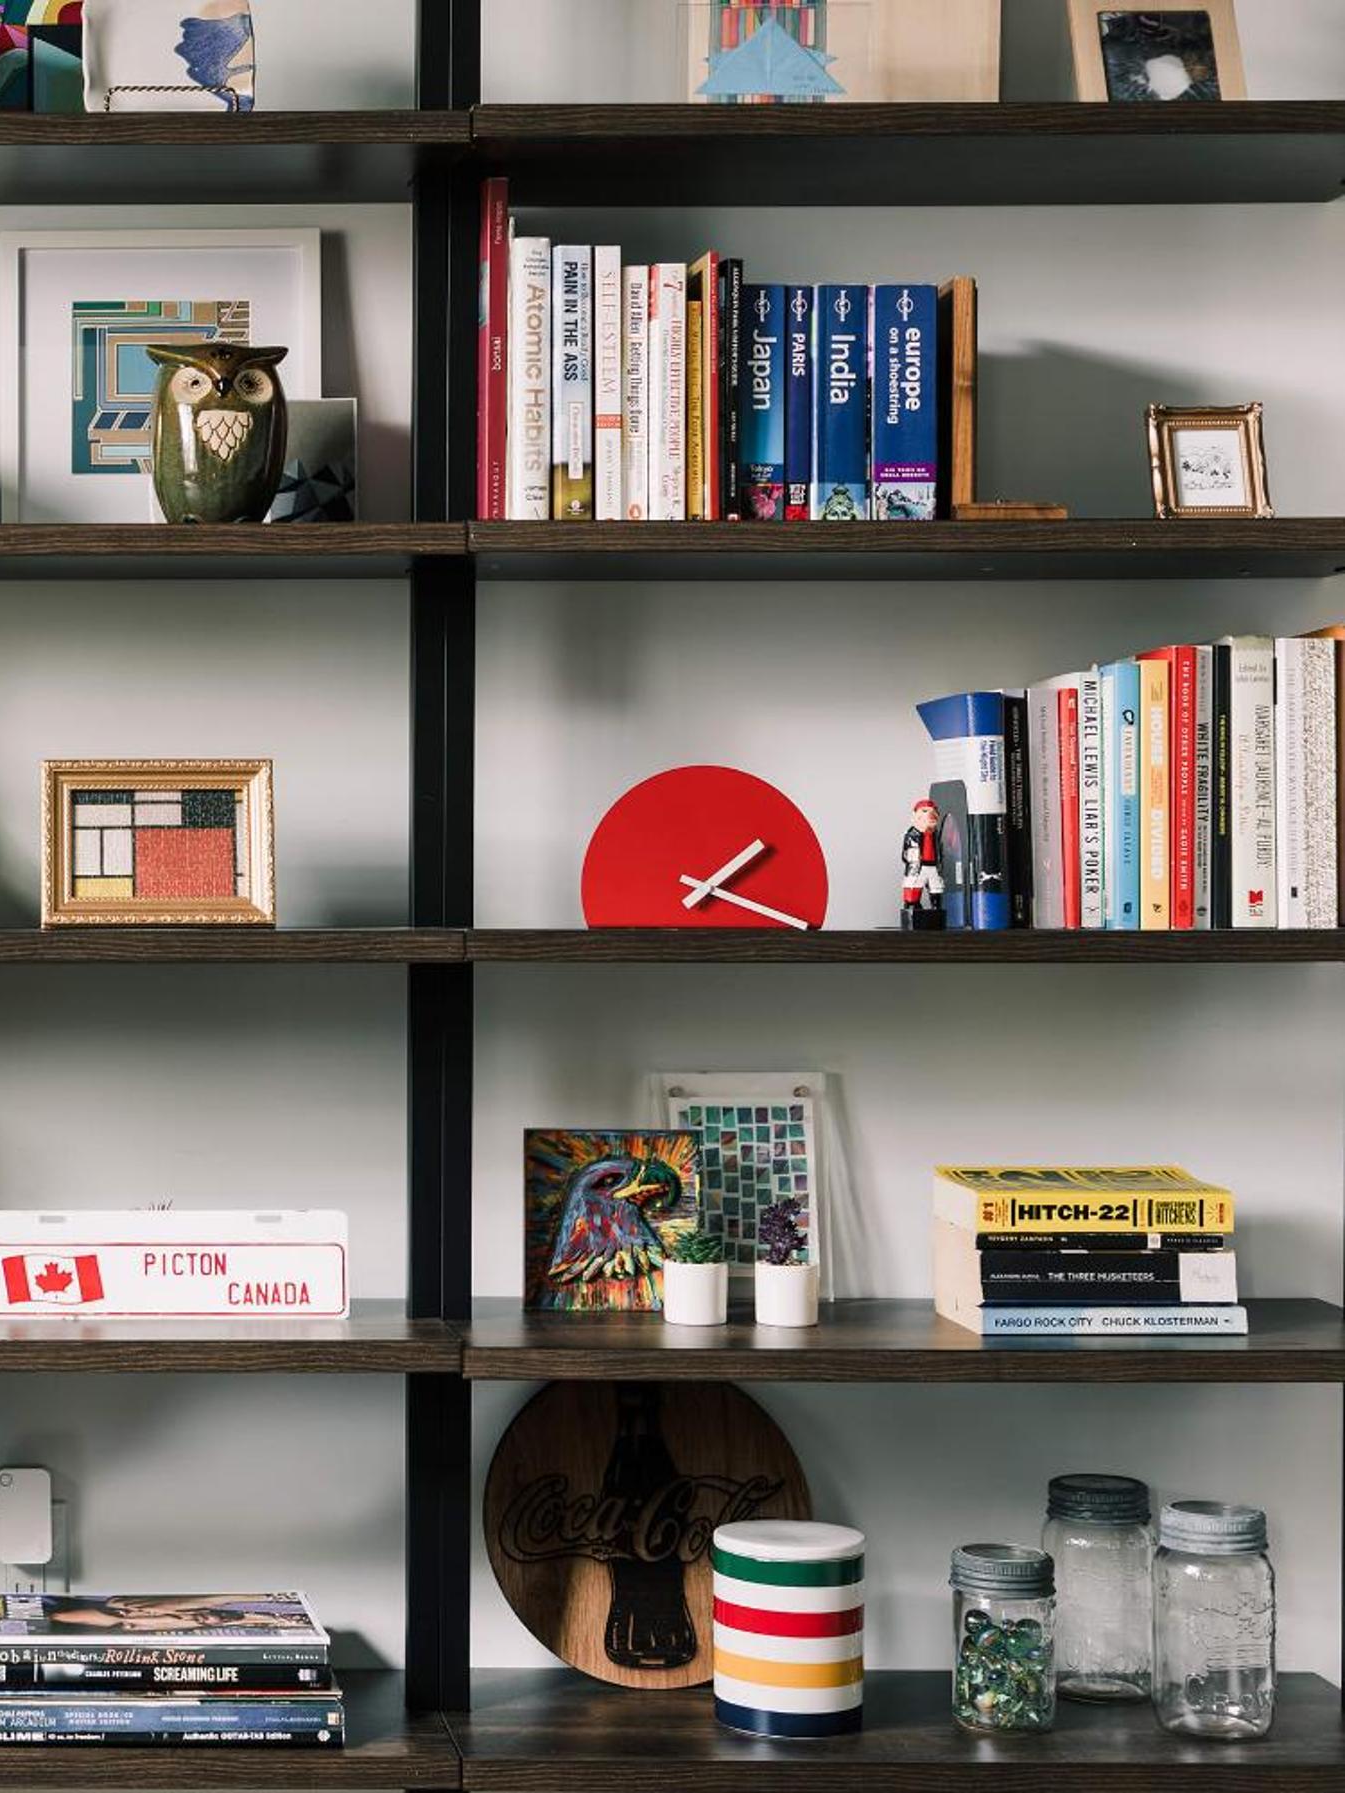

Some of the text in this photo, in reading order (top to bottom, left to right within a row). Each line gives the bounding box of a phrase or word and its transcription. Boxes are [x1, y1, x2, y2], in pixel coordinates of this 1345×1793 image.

[662, 279, 684, 292] 7
[563, 260, 579, 382] PAIN IN THE ASS
[629, 282, 643, 336] David Allen
[524, 283, 547, 380] Atomic
[579, 358, 590, 382] Good
[746, 328, 778, 411] Japan
[791, 332, 807, 378] PARIS
[829, 333, 857, 406] India
[899, 327, 923, 413] europe
[627, 341, 643, 434] Getting Things Done
[886, 327, 902, 425] on a shoestring
[524, 387, 547, 473] Habits
[668, 419, 683, 460] PEOPLE
[1196, 722, 1210, 761] WHITE
[1254, 704, 1271, 757] MARGARET
[1083, 680, 1099, 895] MICHAEL LEWIS LIAR'S POKER
[1149, 706, 1164, 881] HOUSE DIVIDED
[1180, 760, 1190, 796] PEOPLE
[1197, 764, 1210, 823] FRAGILITY
[1017, 1203, 1131, 1221] HITCH-22
[1155, 1206, 1197, 1225] HITCHENS
[143, 1252, 228, 1277] PICTON
[1048, 1271, 1155, 1282] THE THREE MUSKETEERS
[226, 1281, 311, 1306] CANADA
[994, 1315, 1220, 1329] FARGO ROCK CITY CHUCK KLOSTERMAN
[105, 1647, 161, 1664] Rolling
[161, 1648, 206, 1664] Stone
[153, 1666, 215, 1683] SCREAMING
[215, 1667, 240, 1683] LIFE
[9, 1717, 57, 1728] ARCADIUM
[182, 1732, 292, 1740] Authentic Edition
